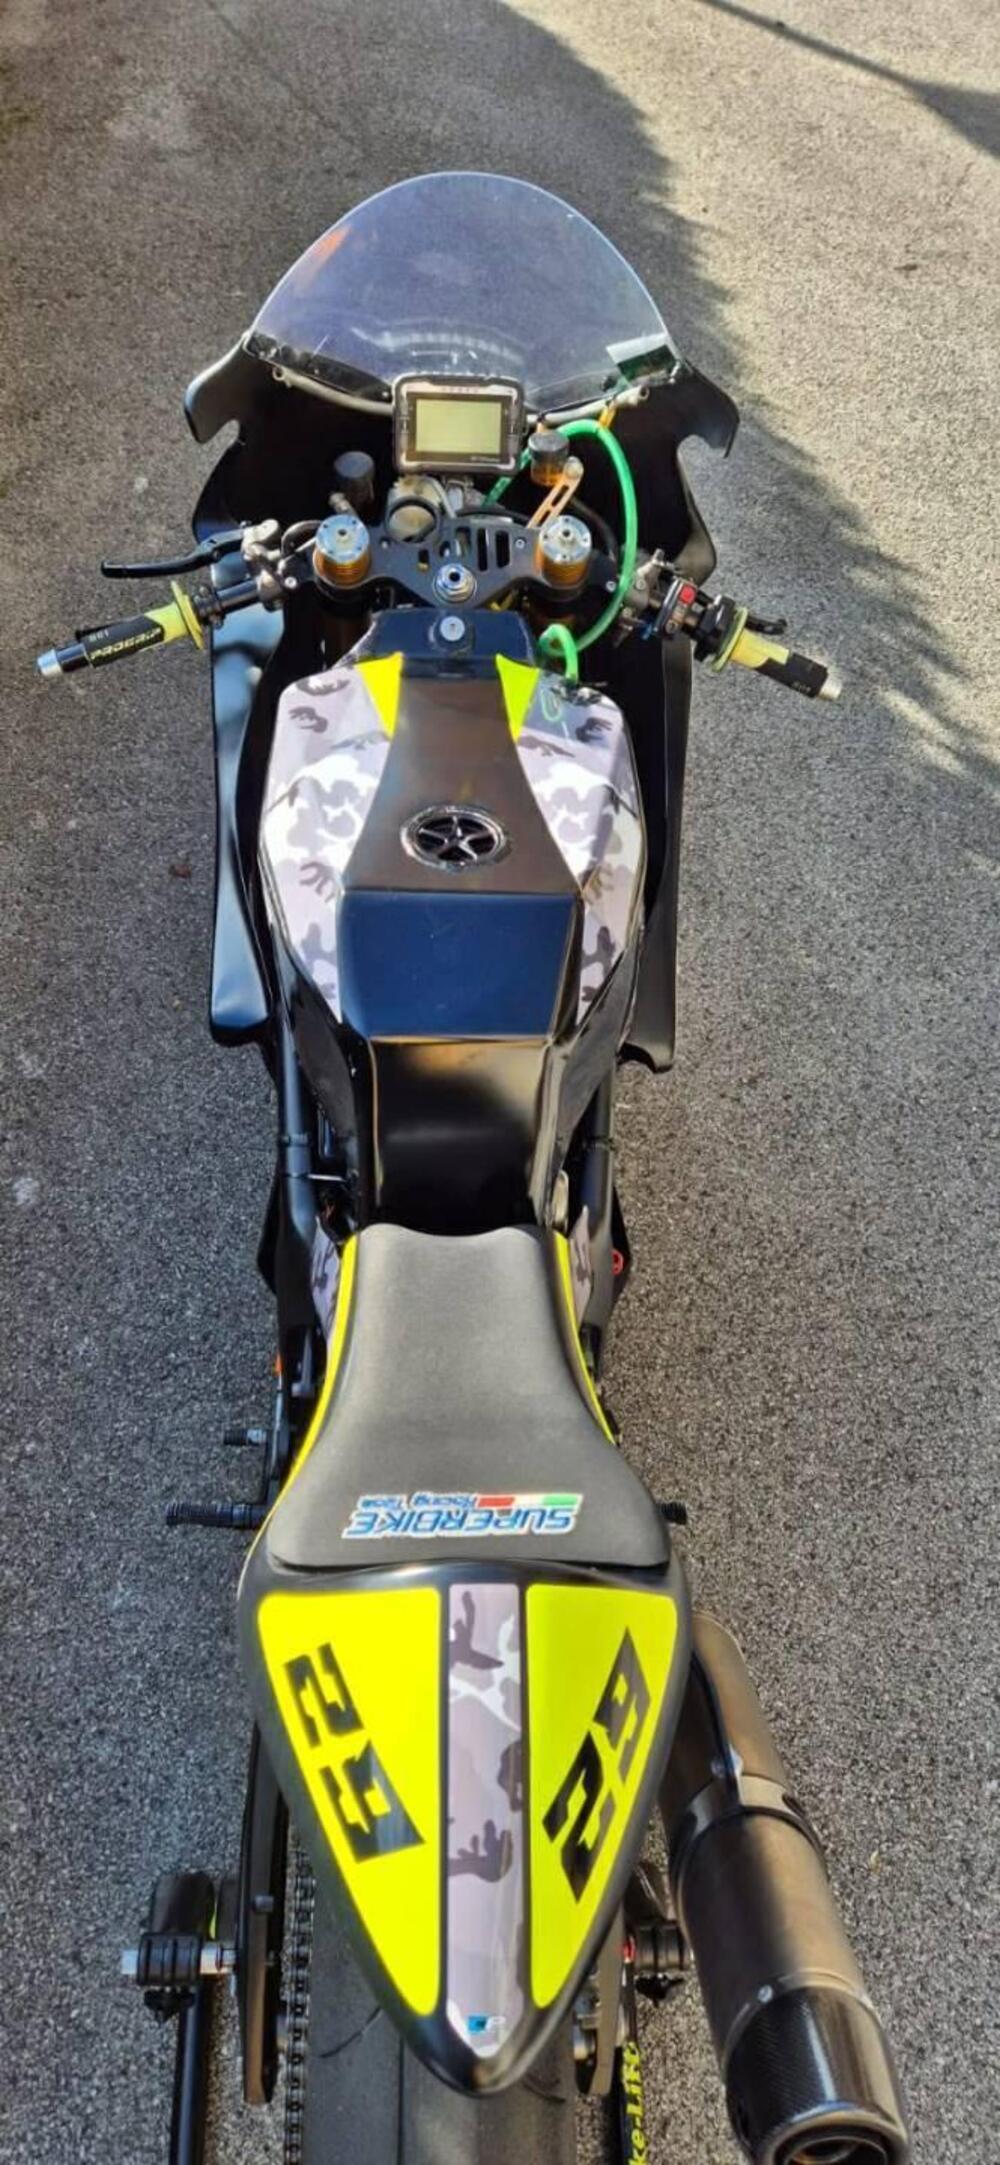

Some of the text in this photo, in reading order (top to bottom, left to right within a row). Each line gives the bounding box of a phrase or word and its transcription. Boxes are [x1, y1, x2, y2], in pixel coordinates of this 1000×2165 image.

[346, 1507, 573, 1536] SUPERBIKE
[411, 1493, 476, 1509] Racing
[283, 1641, 426, 1864] 29
[542, 1626, 652, 1904] 29
